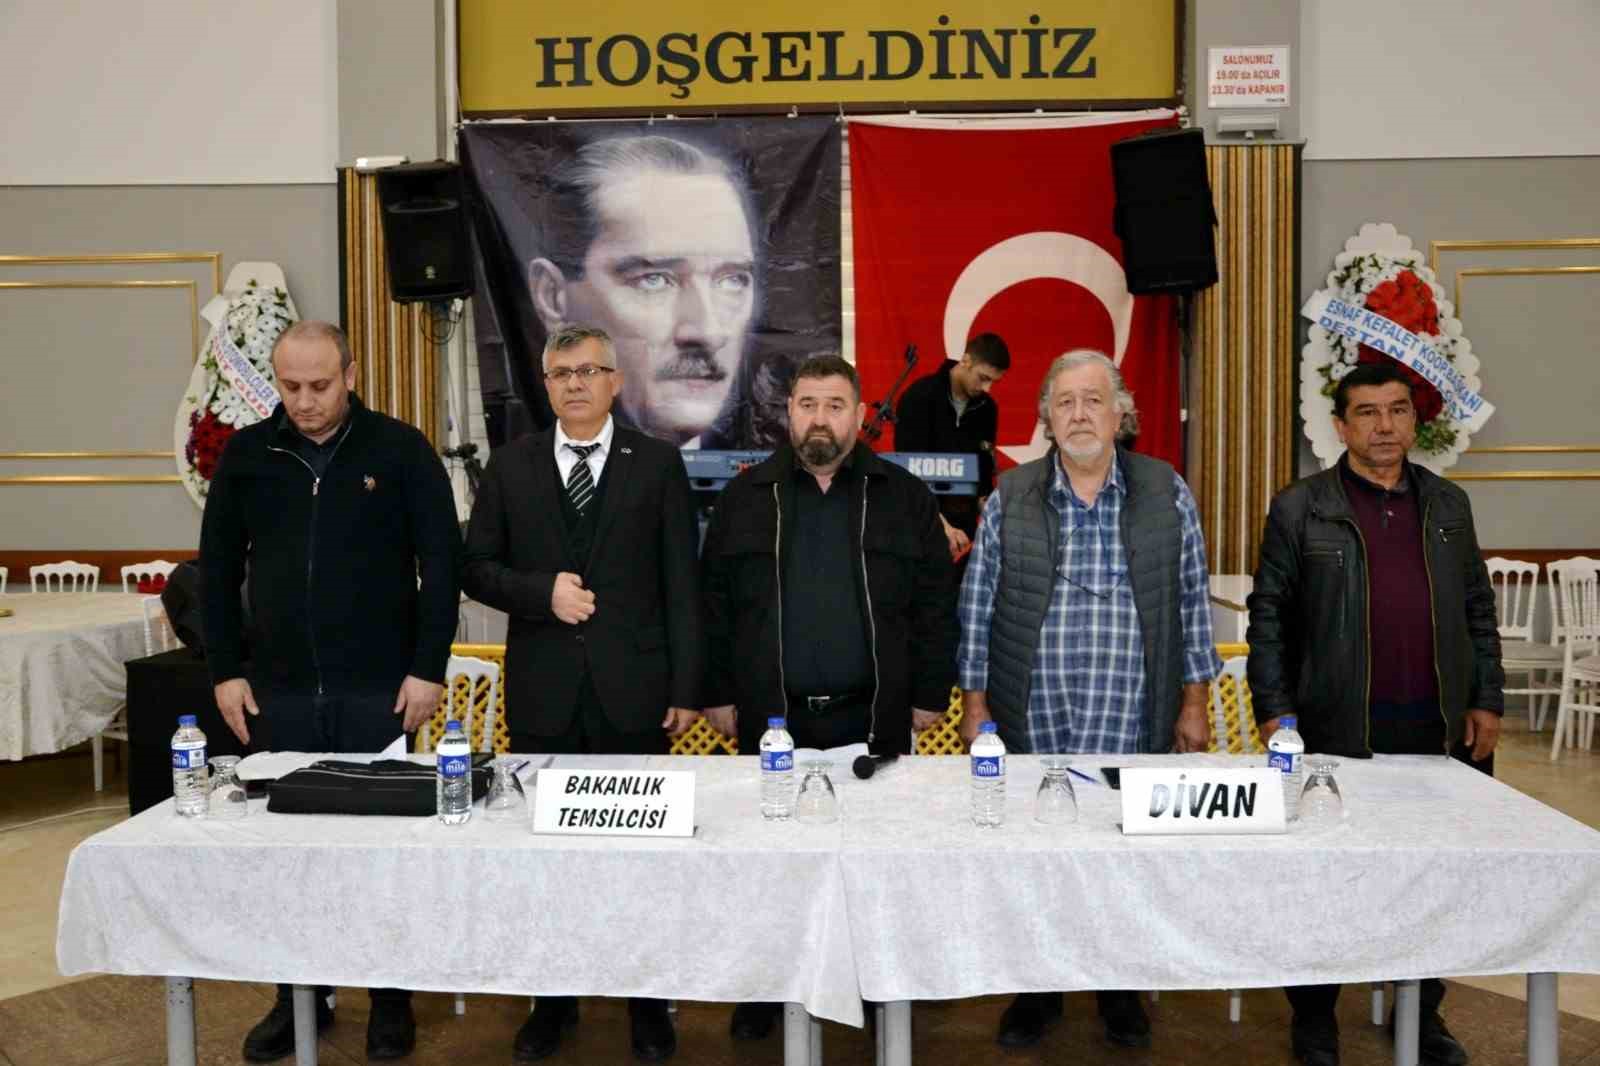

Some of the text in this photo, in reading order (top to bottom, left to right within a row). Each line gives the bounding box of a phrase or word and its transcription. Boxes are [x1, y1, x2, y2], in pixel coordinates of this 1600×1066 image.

[535, 14, 1097, 99] HOŞGELDİNİZ
[1223, 54, 1274, 65] SALONUMUZ
[1252, 69, 1281, 80] AÇILIR
[1247, 84, 1285, 94] KAPANIR
[1326, 299, 1362, 321] ESNAF
[1362, 313, 1419, 349] KEFALET
[1320, 316, 1405, 359] DESTAN
[908, 457, 964, 477] KORG
[977, 765, 998, 776] mila
[564, 775, 666, 796] BAKANLIK
[1148, 773, 1257, 819] DİVAN
[558, 803, 668, 829] TEMSİLCİSİ
